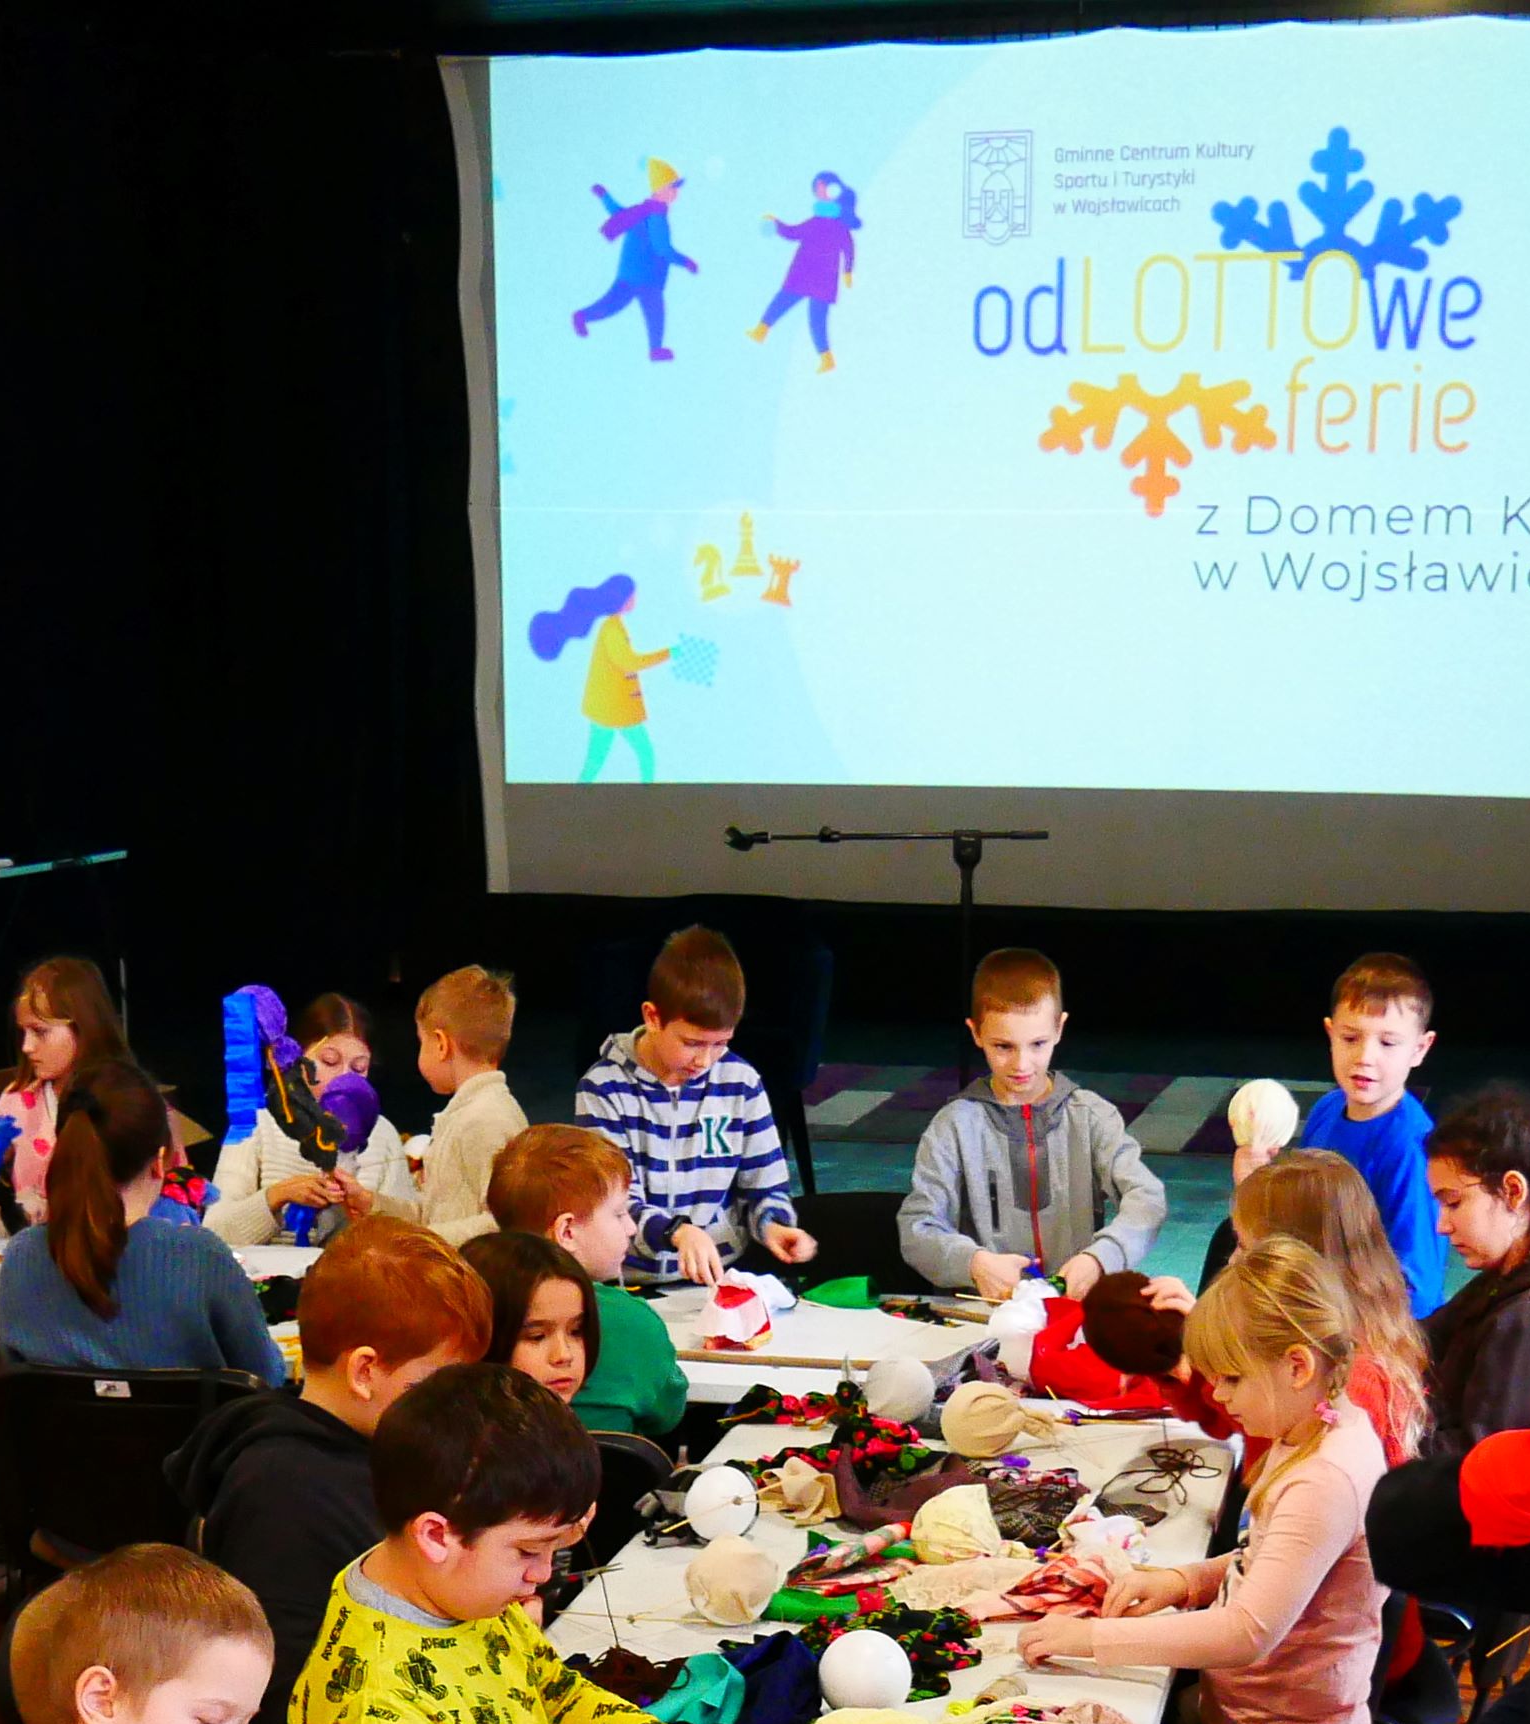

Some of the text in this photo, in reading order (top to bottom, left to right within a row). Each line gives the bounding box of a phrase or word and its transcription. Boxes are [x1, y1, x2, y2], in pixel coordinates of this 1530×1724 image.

[1054, 141, 1255, 164] Gminne Centrum Kultury
[1054, 173, 1108, 191] Sportu
[1122, 168, 1196, 189] Turystyki
[1053, 195, 1180, 216] w Wojsławicach
[972, 249, 1483, 357] odLOTTOwe
[1285, 356, 1477, 454] ferie
[1196, 503, 1220, 536] z
[1246, 494, 1472, 536] Domem
[1192, 560, 1238, 591] w
[702, 1115, 732, 1156] K
